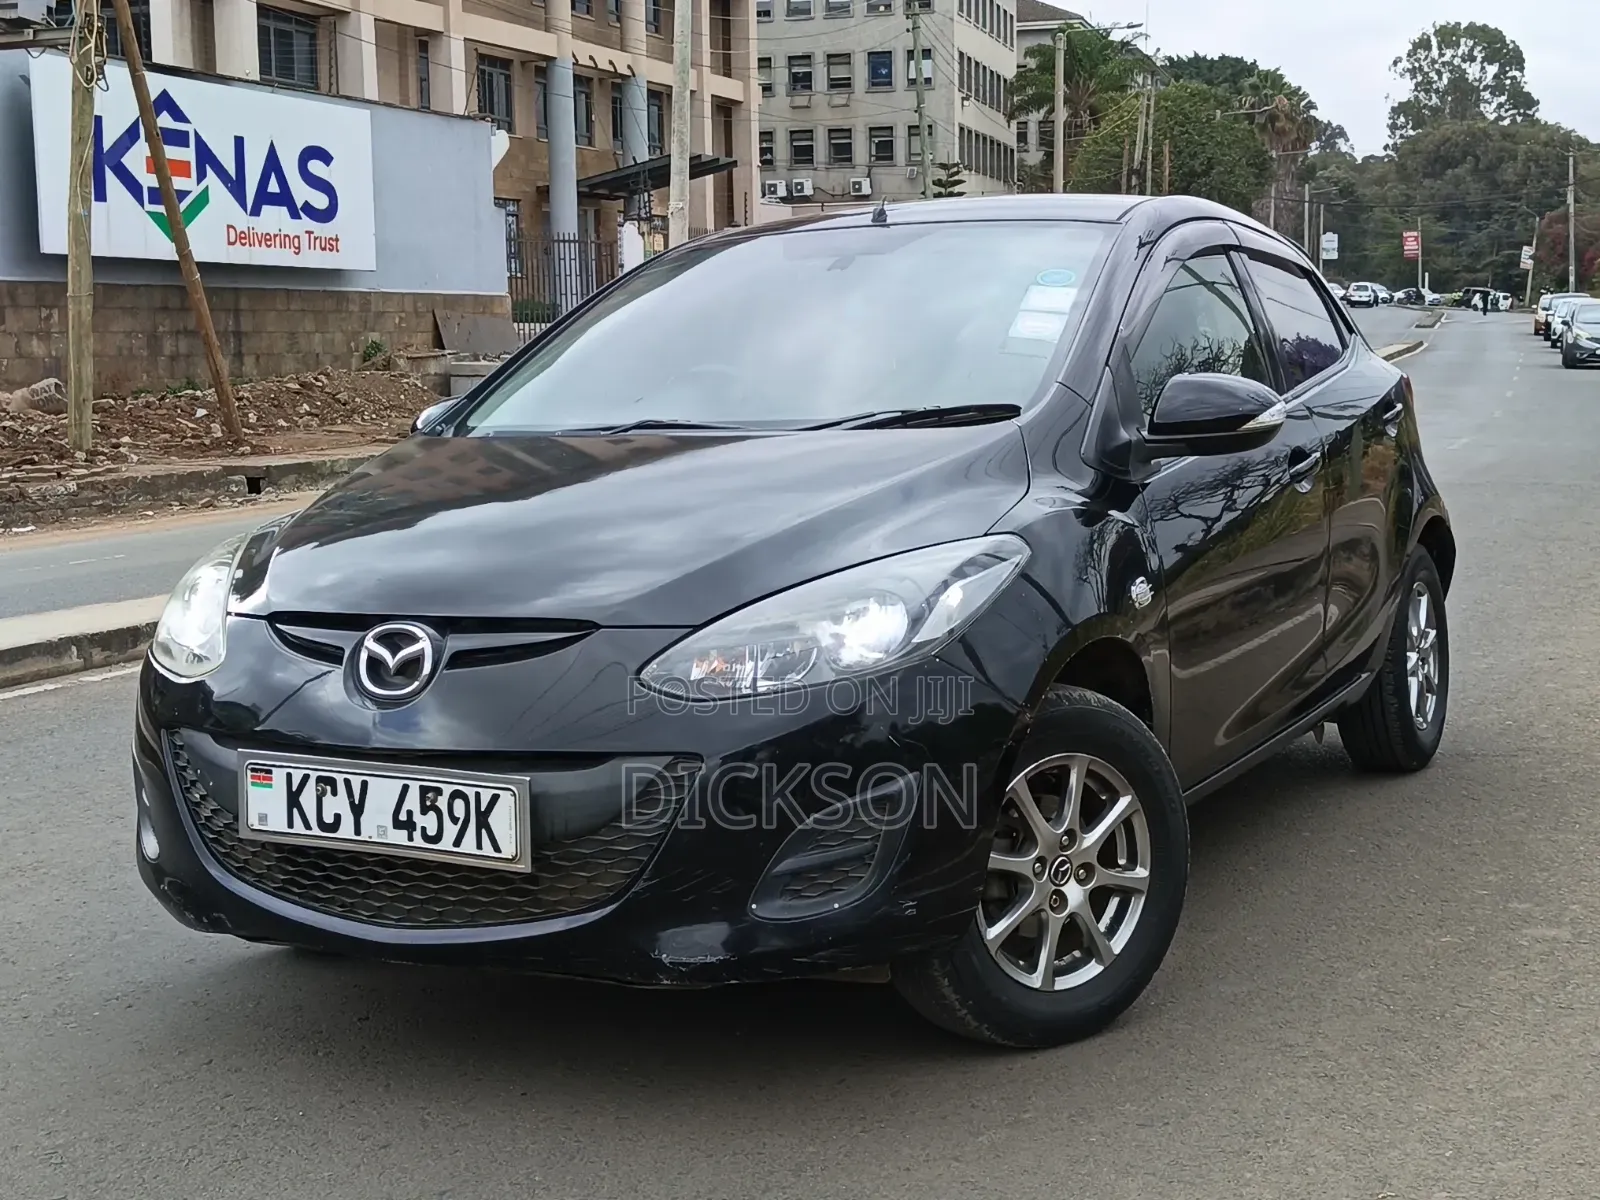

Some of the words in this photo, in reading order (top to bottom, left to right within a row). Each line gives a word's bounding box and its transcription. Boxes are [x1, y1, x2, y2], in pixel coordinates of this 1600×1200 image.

[93, 110, 339, 225] KENAS
[226, 223, 302, 256] Delivering
[305, 229, 341, 254] Trust
[285, 771, 369, 837] KCY
[392, 783, 503, 854] 459K
